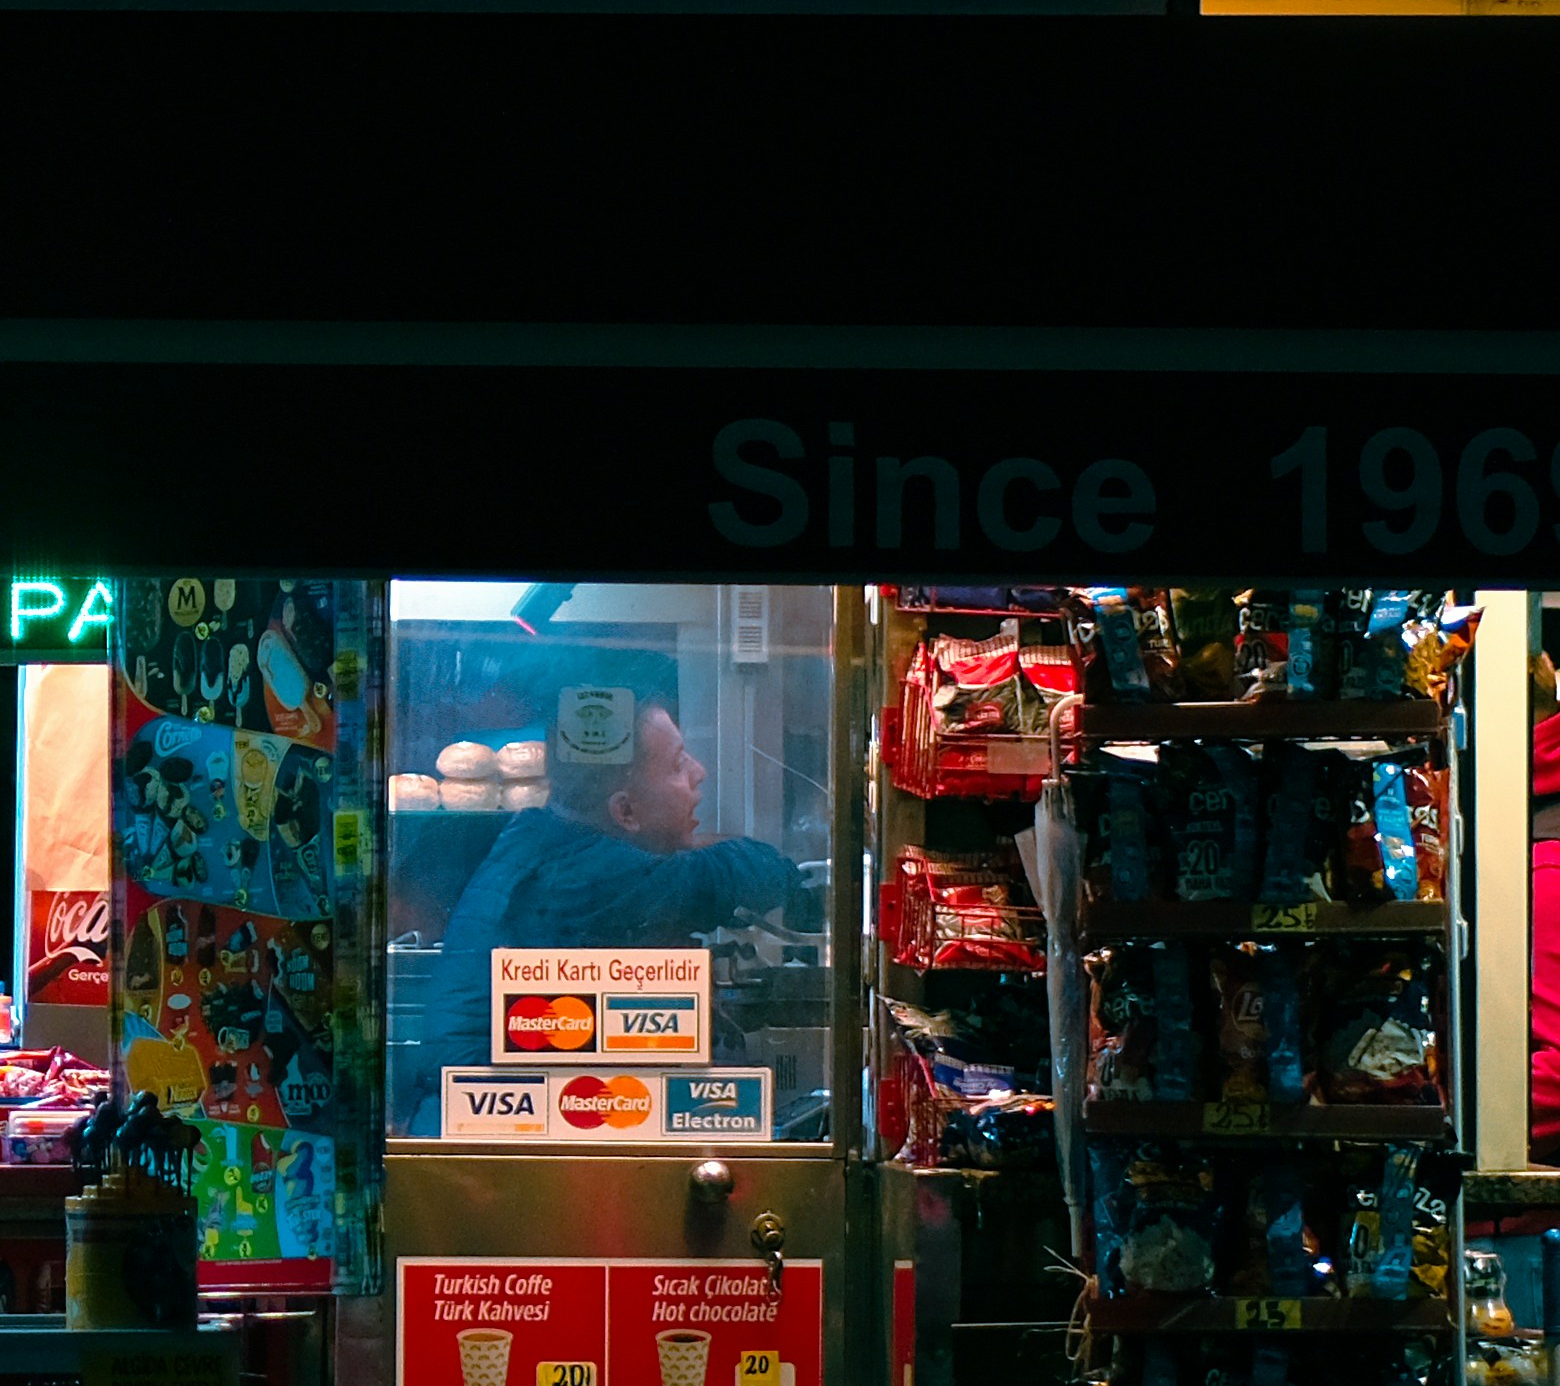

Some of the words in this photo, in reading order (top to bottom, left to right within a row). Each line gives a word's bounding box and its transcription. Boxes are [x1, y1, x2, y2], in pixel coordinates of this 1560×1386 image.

[707, 416, 1157, 552] Since
[501, 958, 549, 982] Kredi
[557, 958, 601, 982] Kartı
[608, 958, 700, 986] Geçerlidir
[507, 1015, 594, 1032] MasterCard
[620, 1012, 680, 1034] VISA
[462, 1091, 535, 1116] VISA
[560, 1094, 651, 1113] MasterCard
[688, 1082, 738, 1099] VISA
[671, 1112, 756, 1130] Electron
[433, 1273, 501, 1296] Turkish
[503, 1273, 553, 1296] Coffe
[652, 1274, 701, 1296] Sıcak
[703, 1274, 778, 1300] Çikolat
[433, 1300, 474, 1322] Türk
[477, 1300, 550, 1322] Kahvesi
[651, 1301, 686, 1323] Hot
[688, 1301, 778, 1323] chocolate
[744, 1355, 770, 1376] 20
